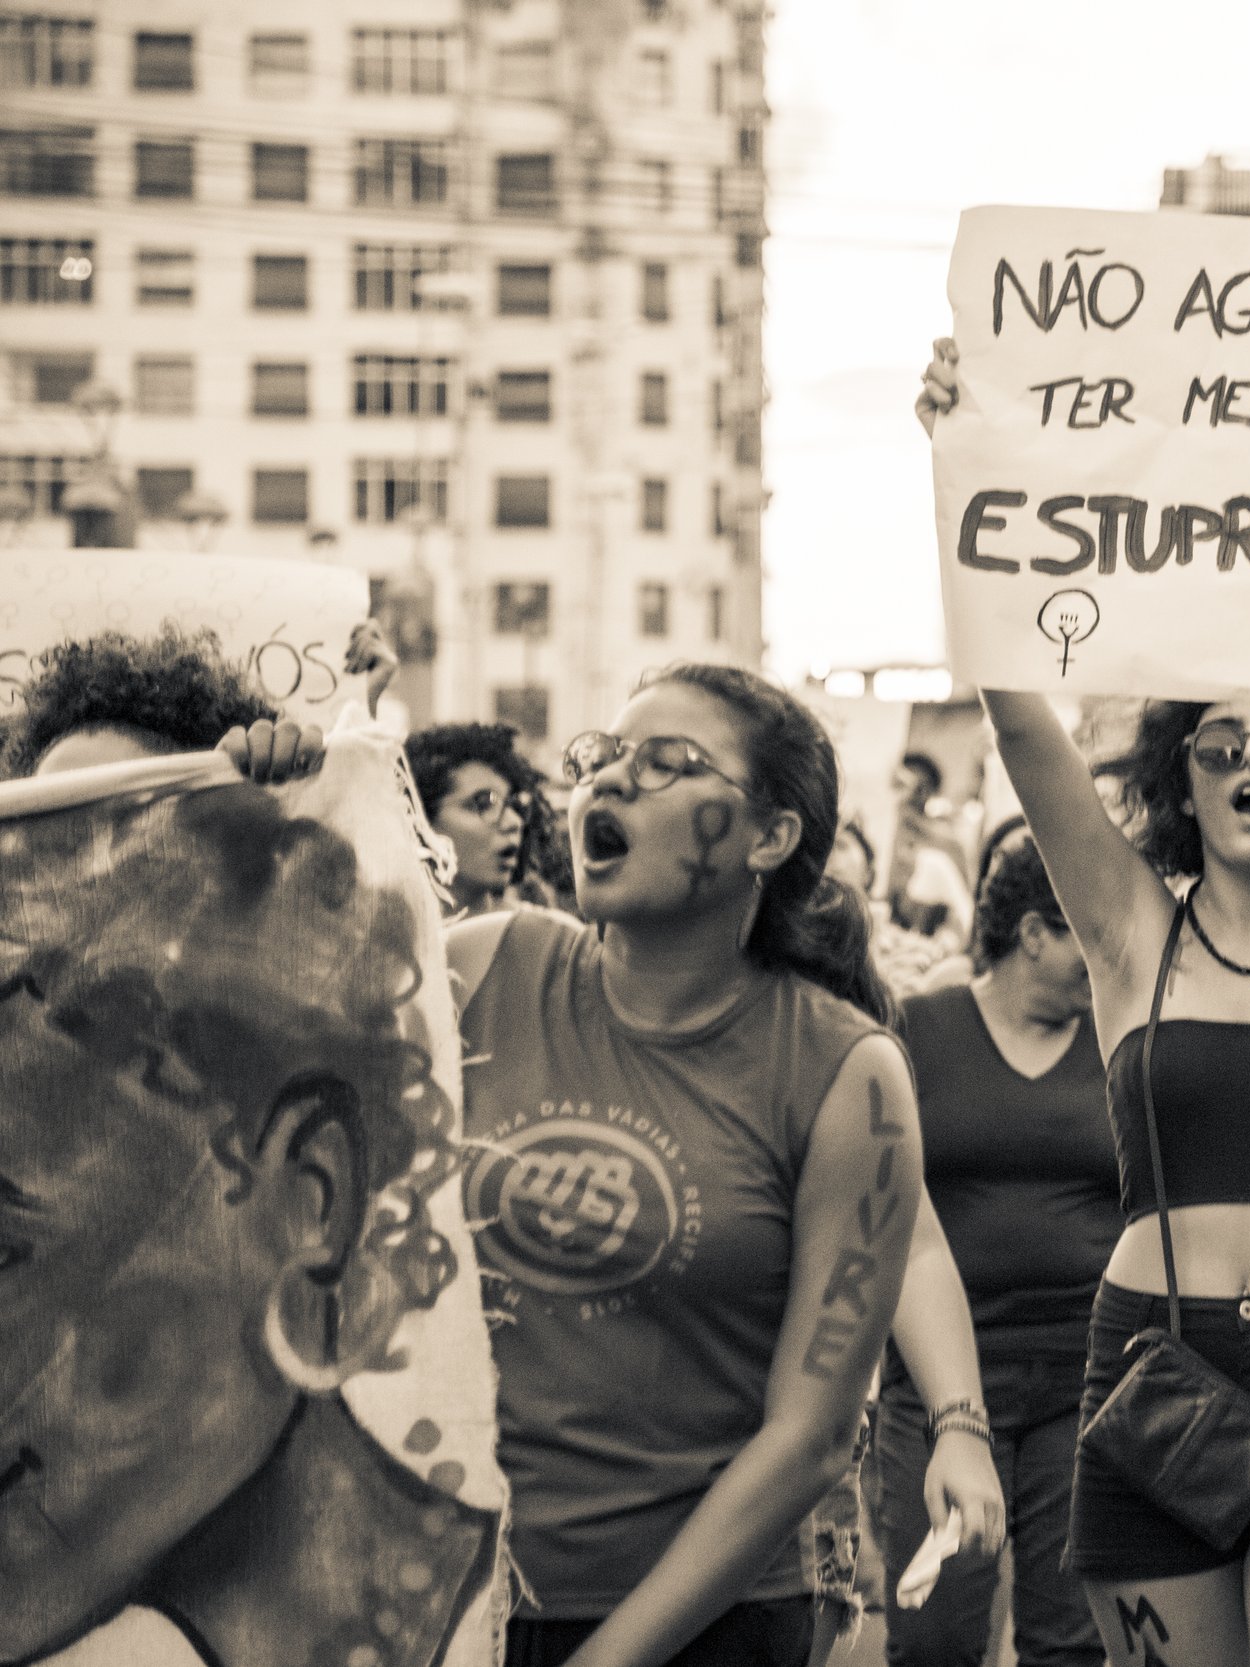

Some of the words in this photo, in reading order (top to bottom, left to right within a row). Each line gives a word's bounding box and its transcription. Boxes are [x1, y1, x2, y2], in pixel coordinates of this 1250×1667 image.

[993, 246, 1144, 337] NÃO
[1029, 376, 1136, 428] TER
[249, 622, 338, 704] ÓS
[540, 1101, 592, 1119] DAS
[607, 1105, 681, 1159] VADIAS
